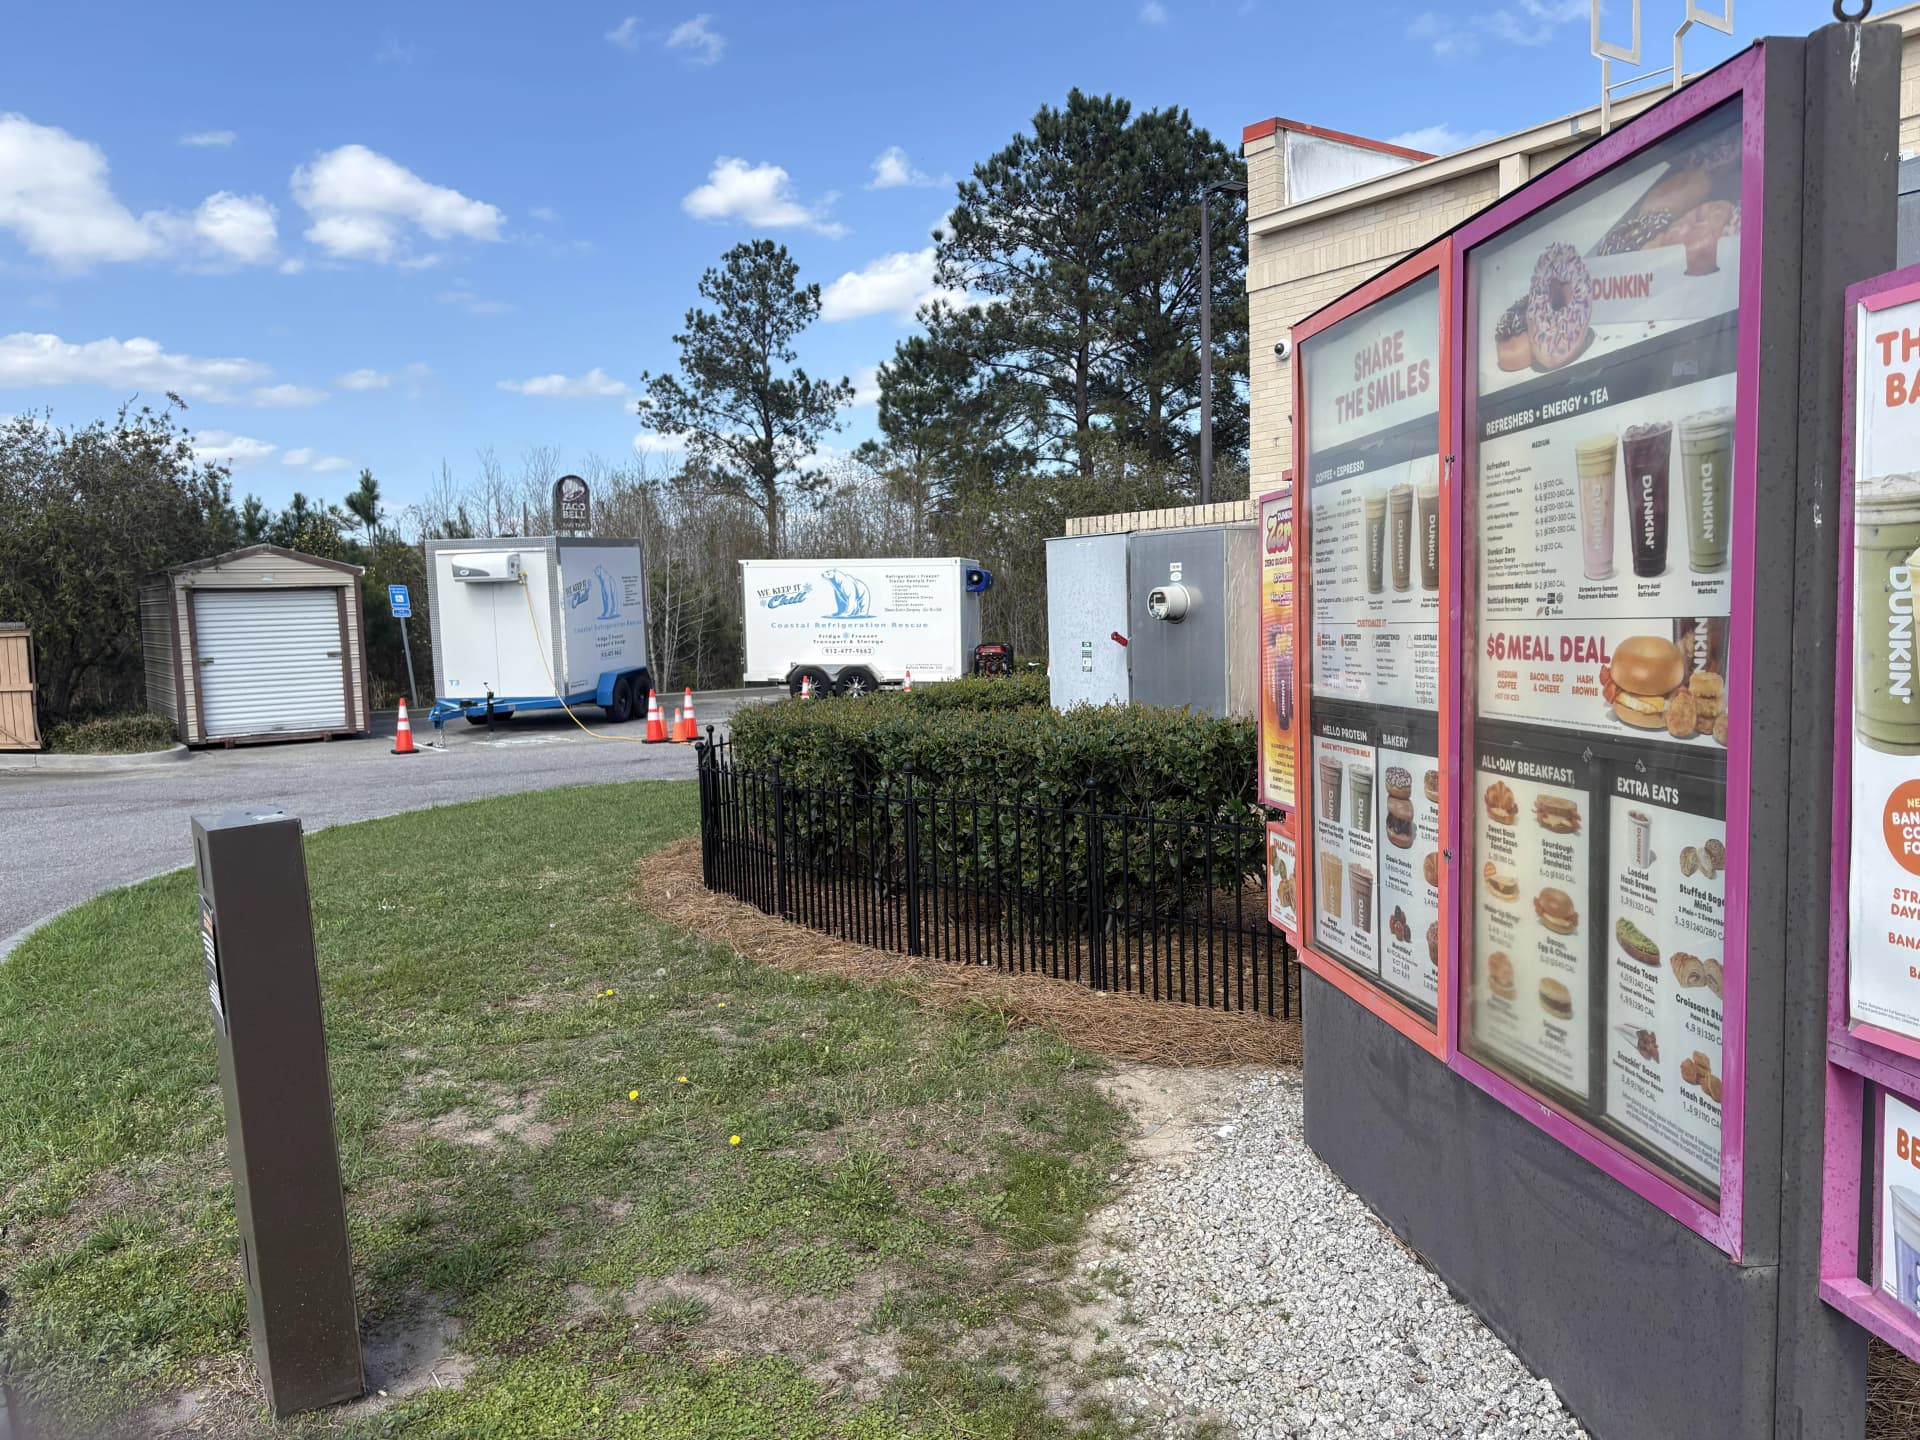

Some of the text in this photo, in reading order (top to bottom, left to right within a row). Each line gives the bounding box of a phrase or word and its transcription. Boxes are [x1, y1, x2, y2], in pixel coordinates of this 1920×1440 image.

[1592, 272, 1654, 300] DUNKIN'
[1354, 330, 1404, 382] SHARE
[1875, 327, 1920, 367] TH
[1335, 358, 1430, 424] THE SMILES
[1486, 386, 1609, 436] REFRESHERS ENERGY TEA
[1315, 460, 1365, 483] COFFEE ESPRESSO
[562, 503, 585, 511] TACO
[1701, 463, 1714, 543] DUNKIN'
[562, 510, 585, 519] BELL
[1641, 475, 1655, 550] DUNKIN'
[1428, 514, 1436, 570] DUNKIN'
[757, 589, 770, 597] WE
[772, 585, 792, 595] KEEP
[768, 591, 807, 609] Chill
[815, 622, 886, 630] Refrigeration
[1889, 567, 1913, 705] DUNKIN'
[1486, 632, 1611, 664] $6 MEAL DEAL
[1497, 680, 1517, 690] COFFEE
[1552, 673, 1564, 682] EGG
[1576, 674, 1594, 684] HASH
[1538, 684, 1560, 694] CHEESE
[1571, 686, 1598, 696] BROWNS
[1322, 724, 1368, 742] HELLO PROTEIN
[1382, 733, 1409, 748] BAKERY
[1517, 761, 1573, 784] BREAKFAST
[1617, 776, 1679, 805] EXTRA EATS
[1541, 838, 1573, 854] Sourdough
[1543, 848, 1572, 862] Breakfast
[1543, 857, 1572, 872] Sandwich
[1627, 866, 1649, 881] Loaded
[1620, 874, 1657, 894] Hash Browns
[1679, 883, 1707, 901] Stuffed
[1893, 887, 1920, 903] STR
[1693, 899, 1713, 913] Minis
[1641, 968, 1658, 984] Toast
[1675, 993, 1710, 1017] Croissant
[1642, 1064, 1661, 1082] Bacon
[1680, 1086, 1698, 1103] Hash
[1896, 1127, 1920, 1170] BE
